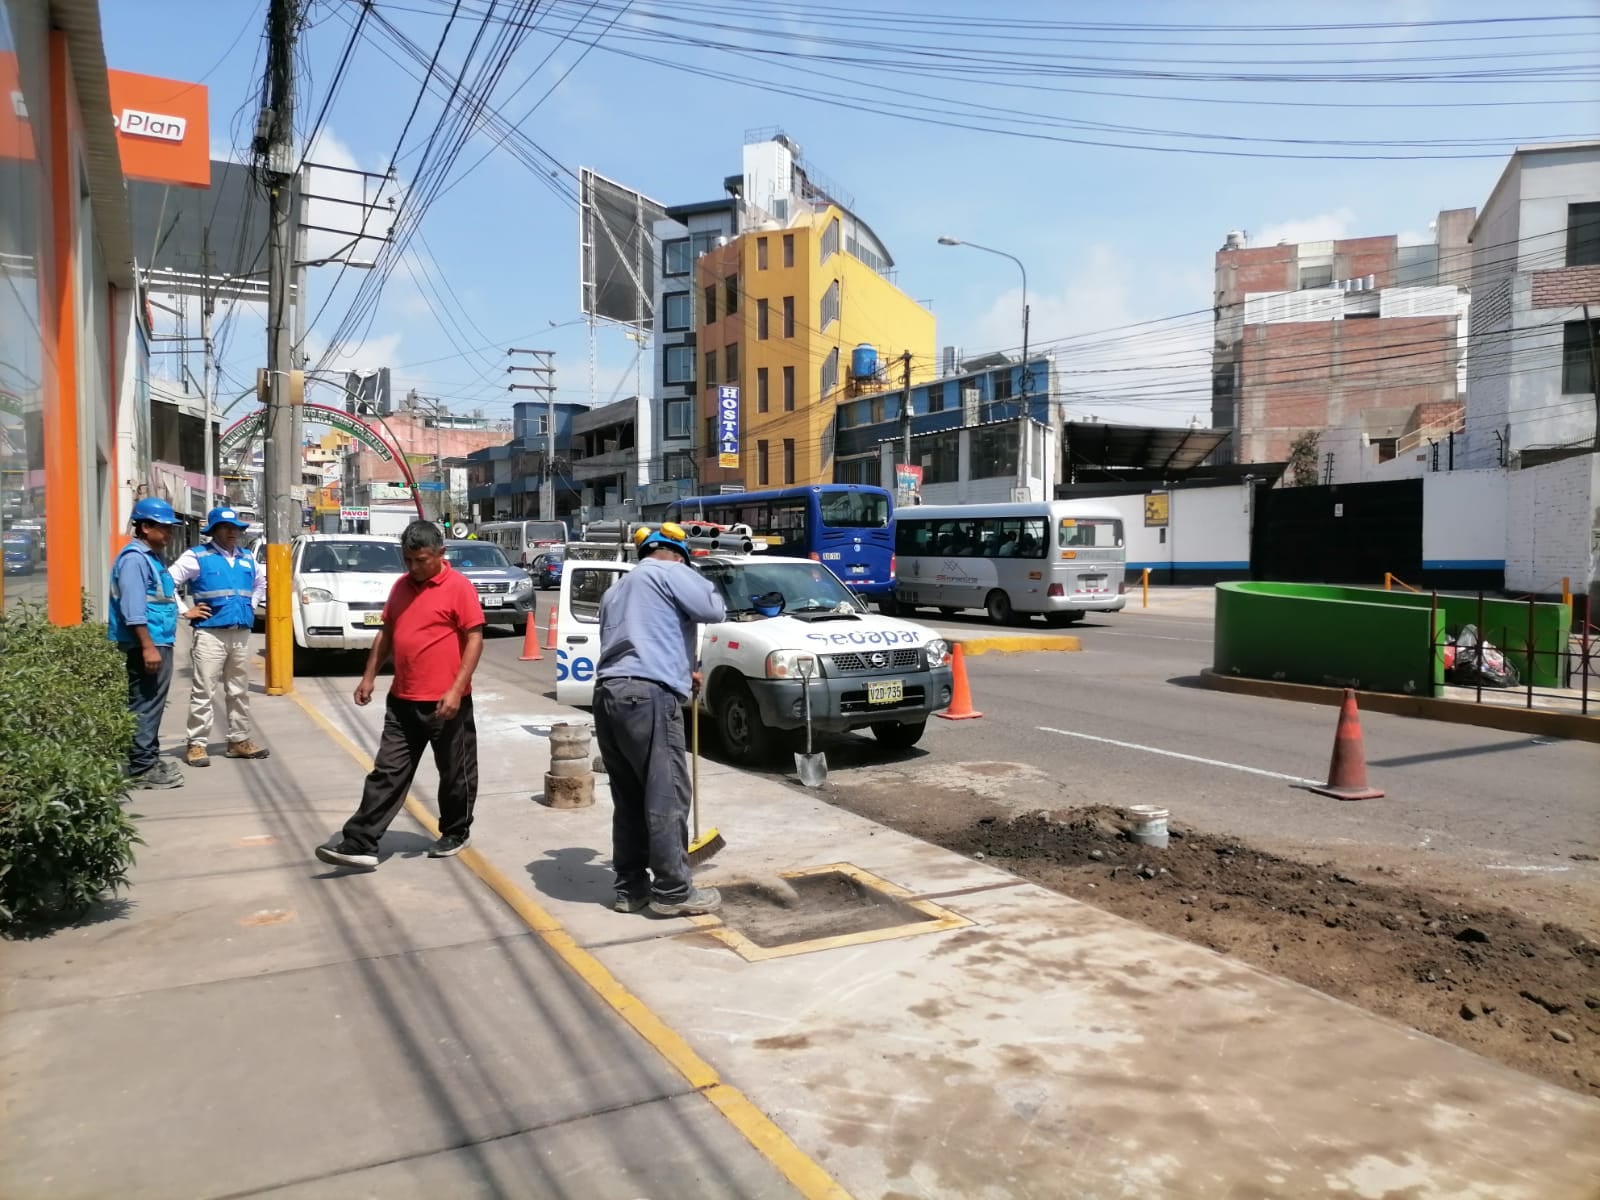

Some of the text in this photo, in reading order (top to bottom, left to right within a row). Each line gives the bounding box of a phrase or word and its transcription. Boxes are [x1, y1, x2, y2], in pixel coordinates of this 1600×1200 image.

[126, 113, 182, 136] Plan
[721, 388, 738, 453] HOSTAL
[353, 424, 385, 454] COLORADO
[557, 649, 594, 682] Se
[869, 686, 902, 701] V2D-735
